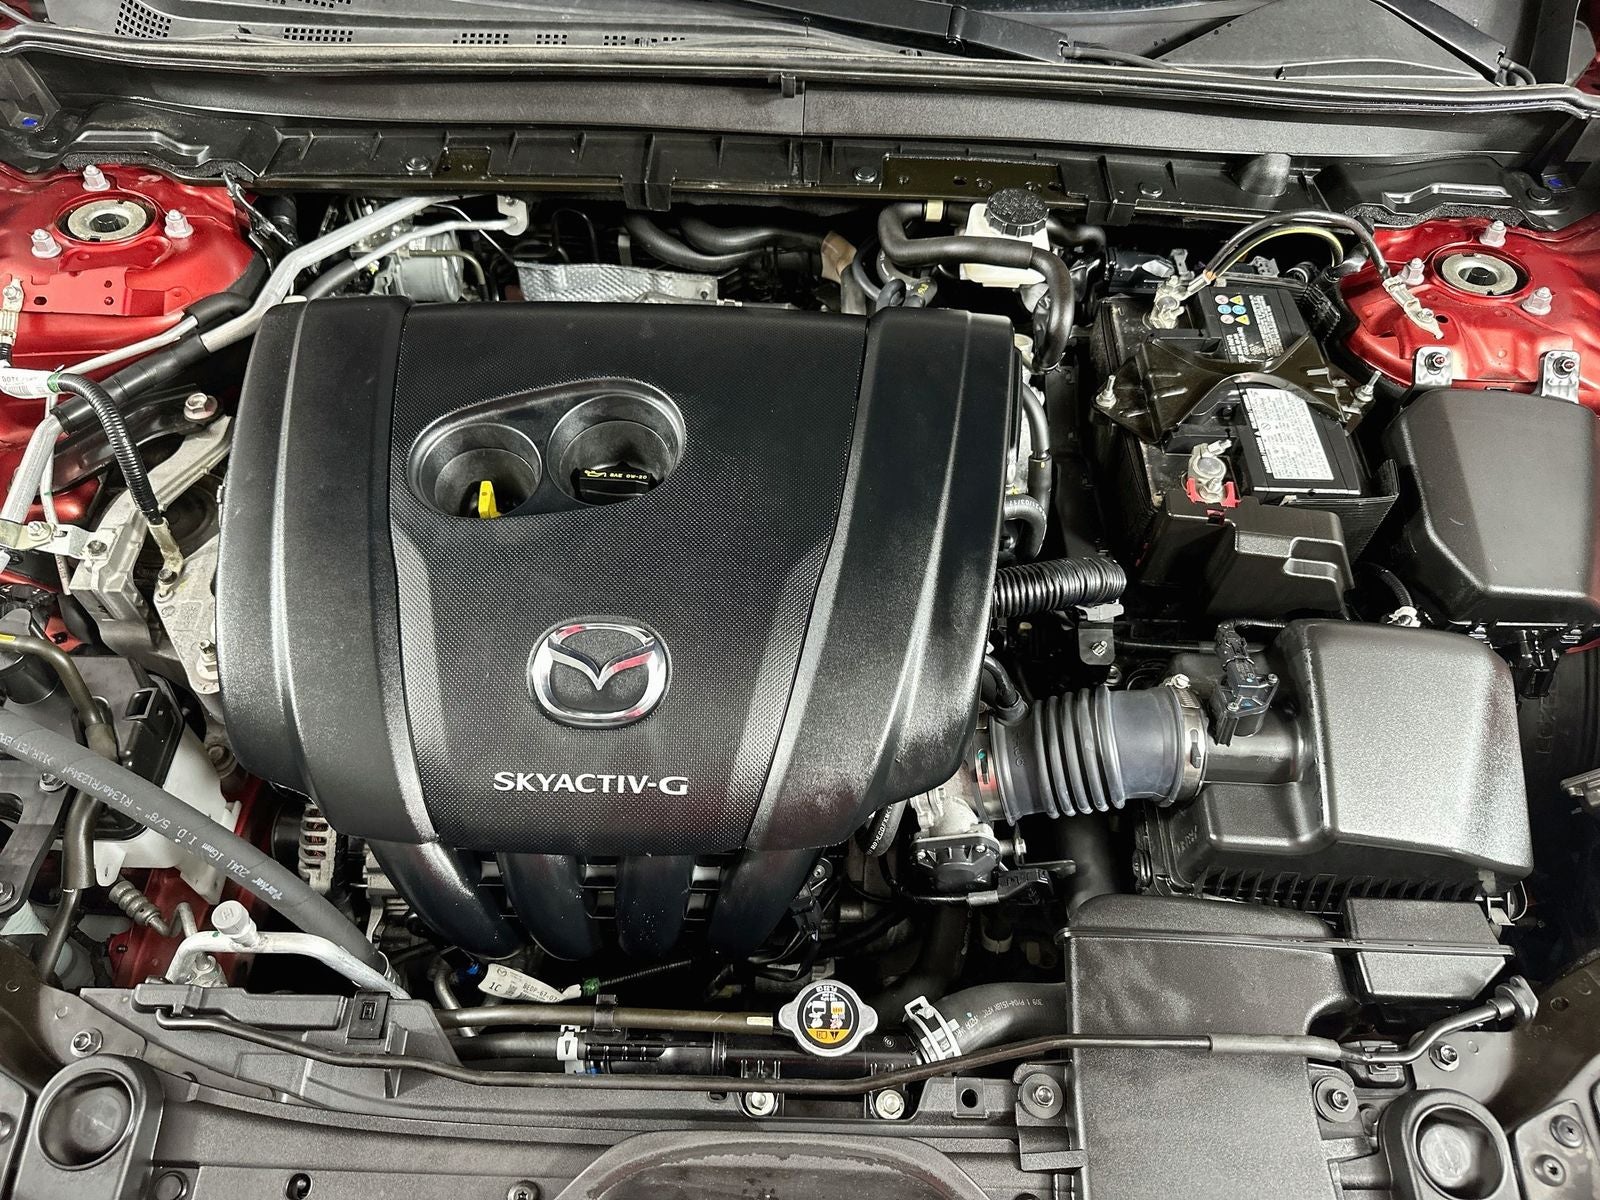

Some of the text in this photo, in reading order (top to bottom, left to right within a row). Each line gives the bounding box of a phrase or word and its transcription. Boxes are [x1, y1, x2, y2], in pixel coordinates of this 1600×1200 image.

[493, 771, 690, 796] SKYACTIV-G
[201, 843, 225, 861] 16mm
[227, 860, 251, 878] 2041
